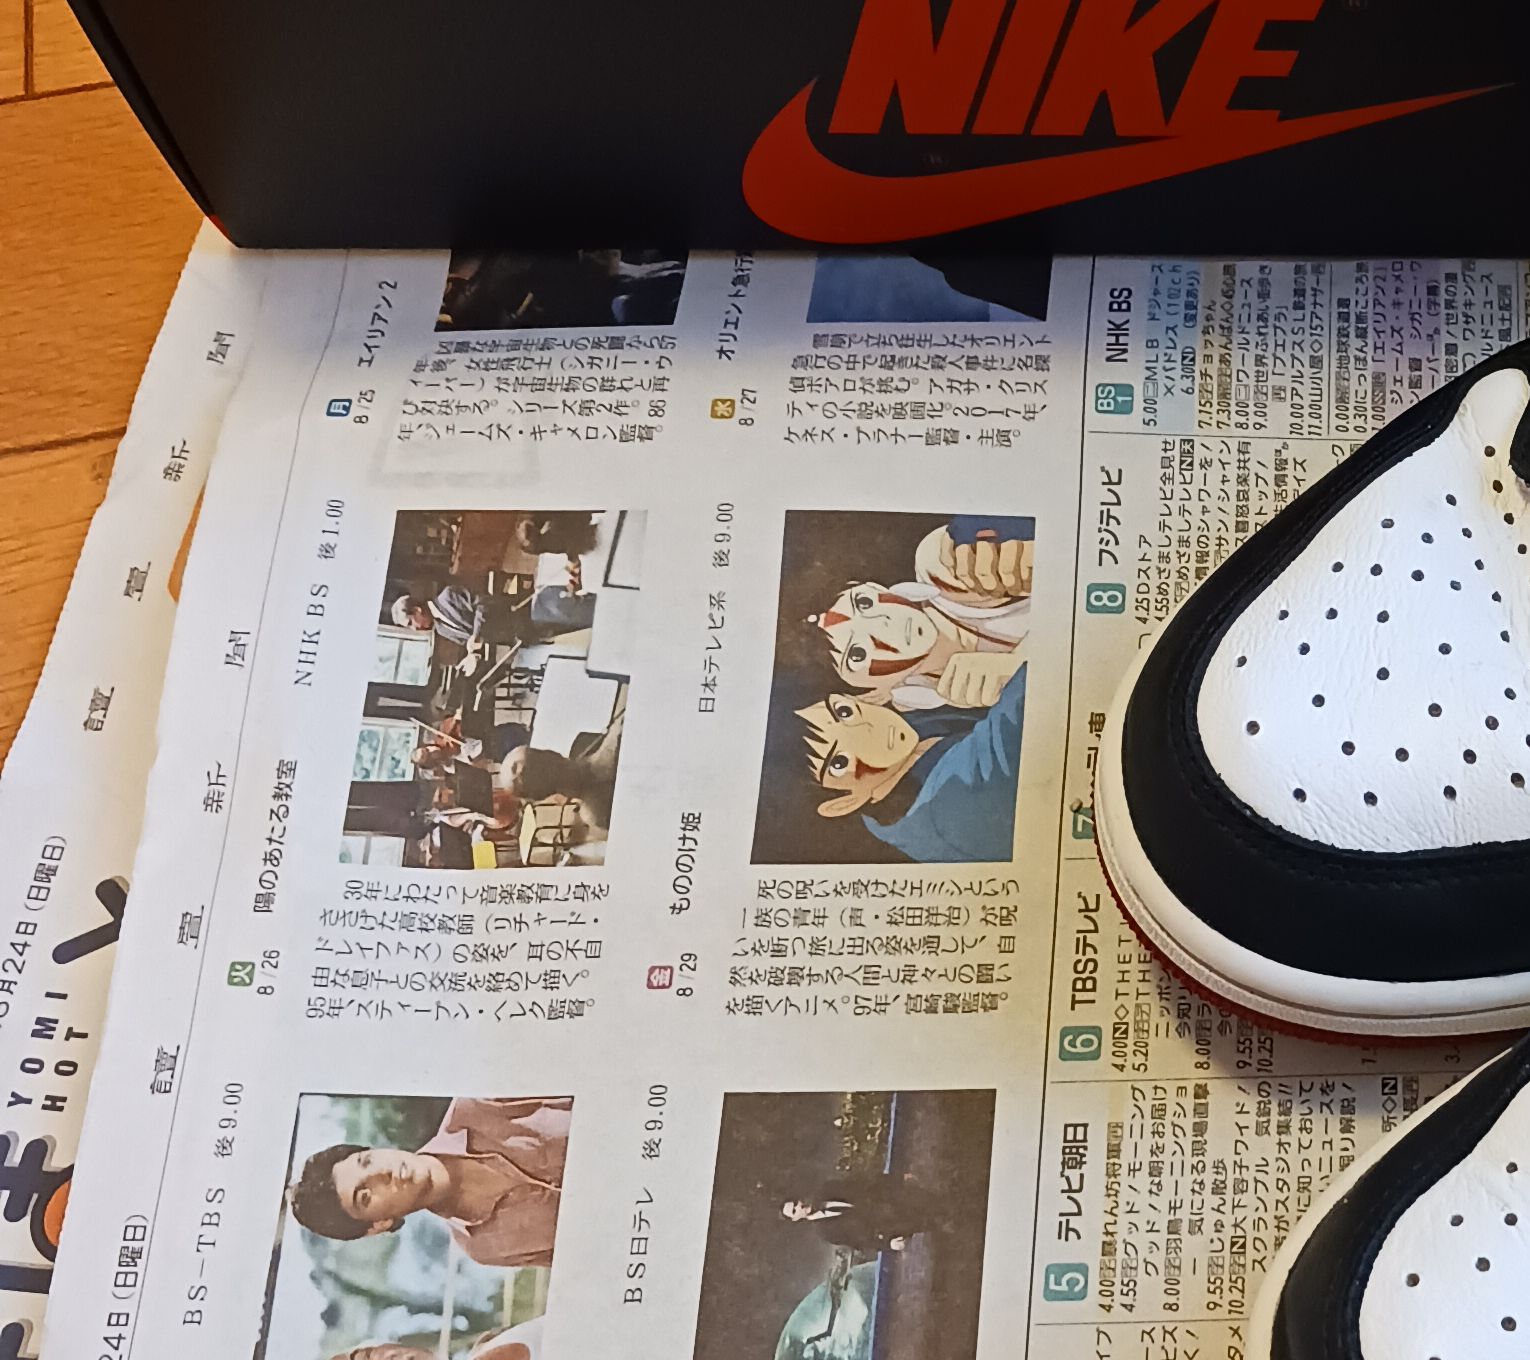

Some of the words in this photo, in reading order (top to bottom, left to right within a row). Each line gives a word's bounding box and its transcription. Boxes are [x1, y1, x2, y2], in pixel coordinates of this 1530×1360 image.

[357, 280, 397, 367] エイリアン2
[716, 250, 754, 360] オリエント急行
[1108, 288, 1132, 313] BS
[1106, 320, 1130, 362] NHK
[317, 500, 346, 560] 後1.00
[712, 503, 735, 567] 後9.00
[1098, 465, 1123, 566] フジテレビ
[306, 582, 329, 617] BS
[293, 630, 323, 687] NHK
[698, 591, 727, 713] 日本テレビ系
[253, 760, 298, 913] 陽のあたる教室
[669, 812, 702, 915] もののけ姫
[344, 880, 609, 905] 30年にわたって音楽教育に身を
[757, 878, 1020, 901] 死の呪いを受けたエミシという
[227, 962, 255, 986] 火
[310, 967, 591, 993] 由な息子との交流を絡めて描く。
[647, 966, 673, 990] 金
[729, 962, 1012, 987] 然を破壊する人間と神々との闘い
[733, 934, 1016, 958] いを断つ旅に出る姿を通して、自
[1071, 892, 1100, 1011] TBSテレビ
[7, 992, 68, 1108] YOMI
[42, 1027, 88, 1111] HOT
[212, 1082, 244, 1158] 後9.00
[624, 1187, 652, 1304] BS日テレ
[641, 1084, 669, 1159] 後9.00
[1058, 1122, 1089, 1242] テレビ朝日
[1252, 1157, 1271, 1273] スクランブル
